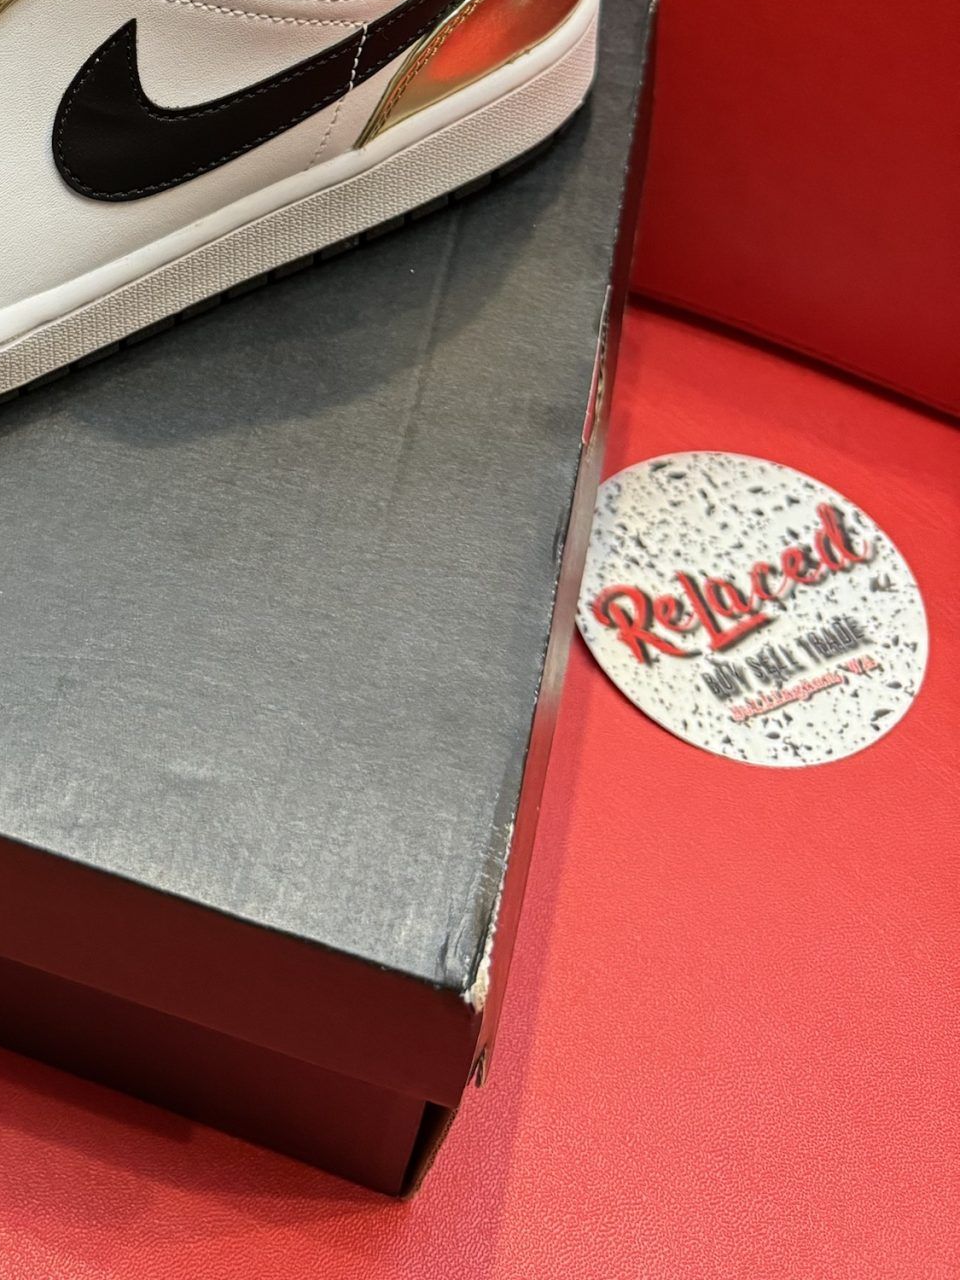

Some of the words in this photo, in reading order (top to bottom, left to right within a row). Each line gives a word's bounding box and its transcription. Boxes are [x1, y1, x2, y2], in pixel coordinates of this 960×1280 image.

[701, 659, 751, 699] BUY
[745, 642, 804, 683] SELL
[794, 616, 864, 663] TRADE
